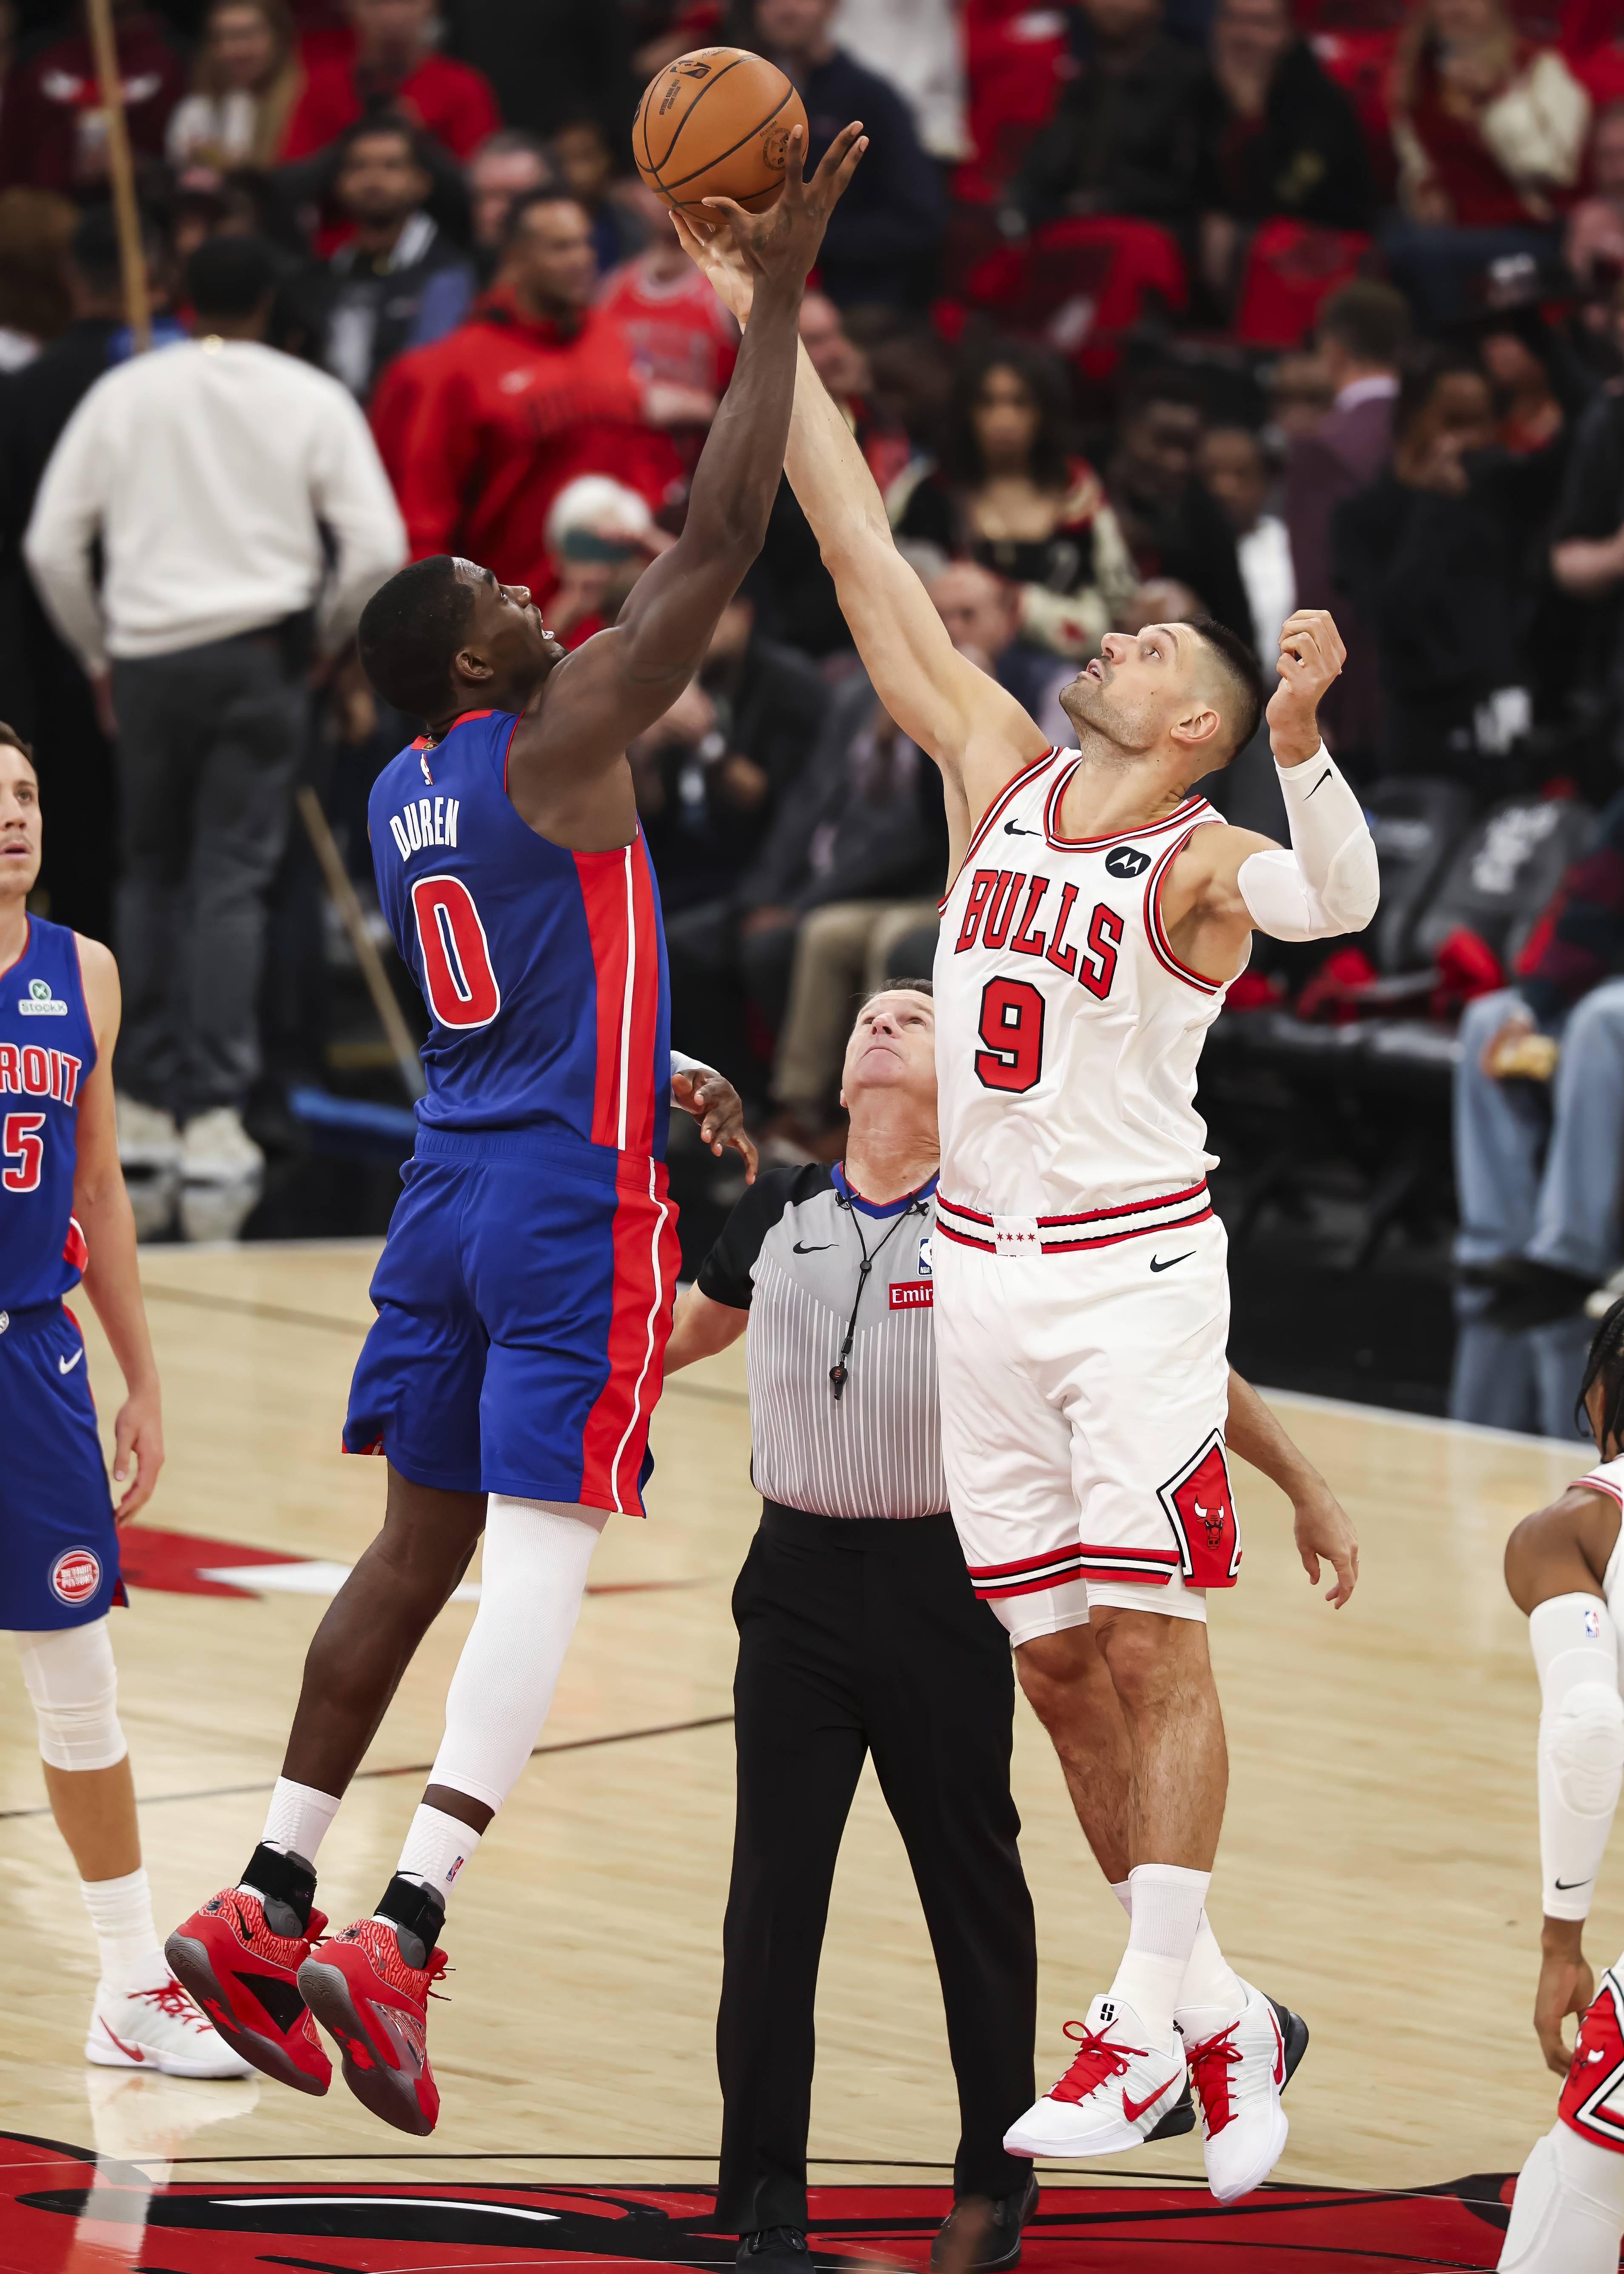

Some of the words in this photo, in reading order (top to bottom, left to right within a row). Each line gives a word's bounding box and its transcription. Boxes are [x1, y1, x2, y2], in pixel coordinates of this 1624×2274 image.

[389, 796, 460, 862] DUREN
[411, 875, 501, 1029] 0
[954, 869, 1124, 1001] BULLS
[974, 976, 1046, 1094] 9
[2, 1112, 46, 1193] 5
[892, 1286, 933, 1303] Emir
